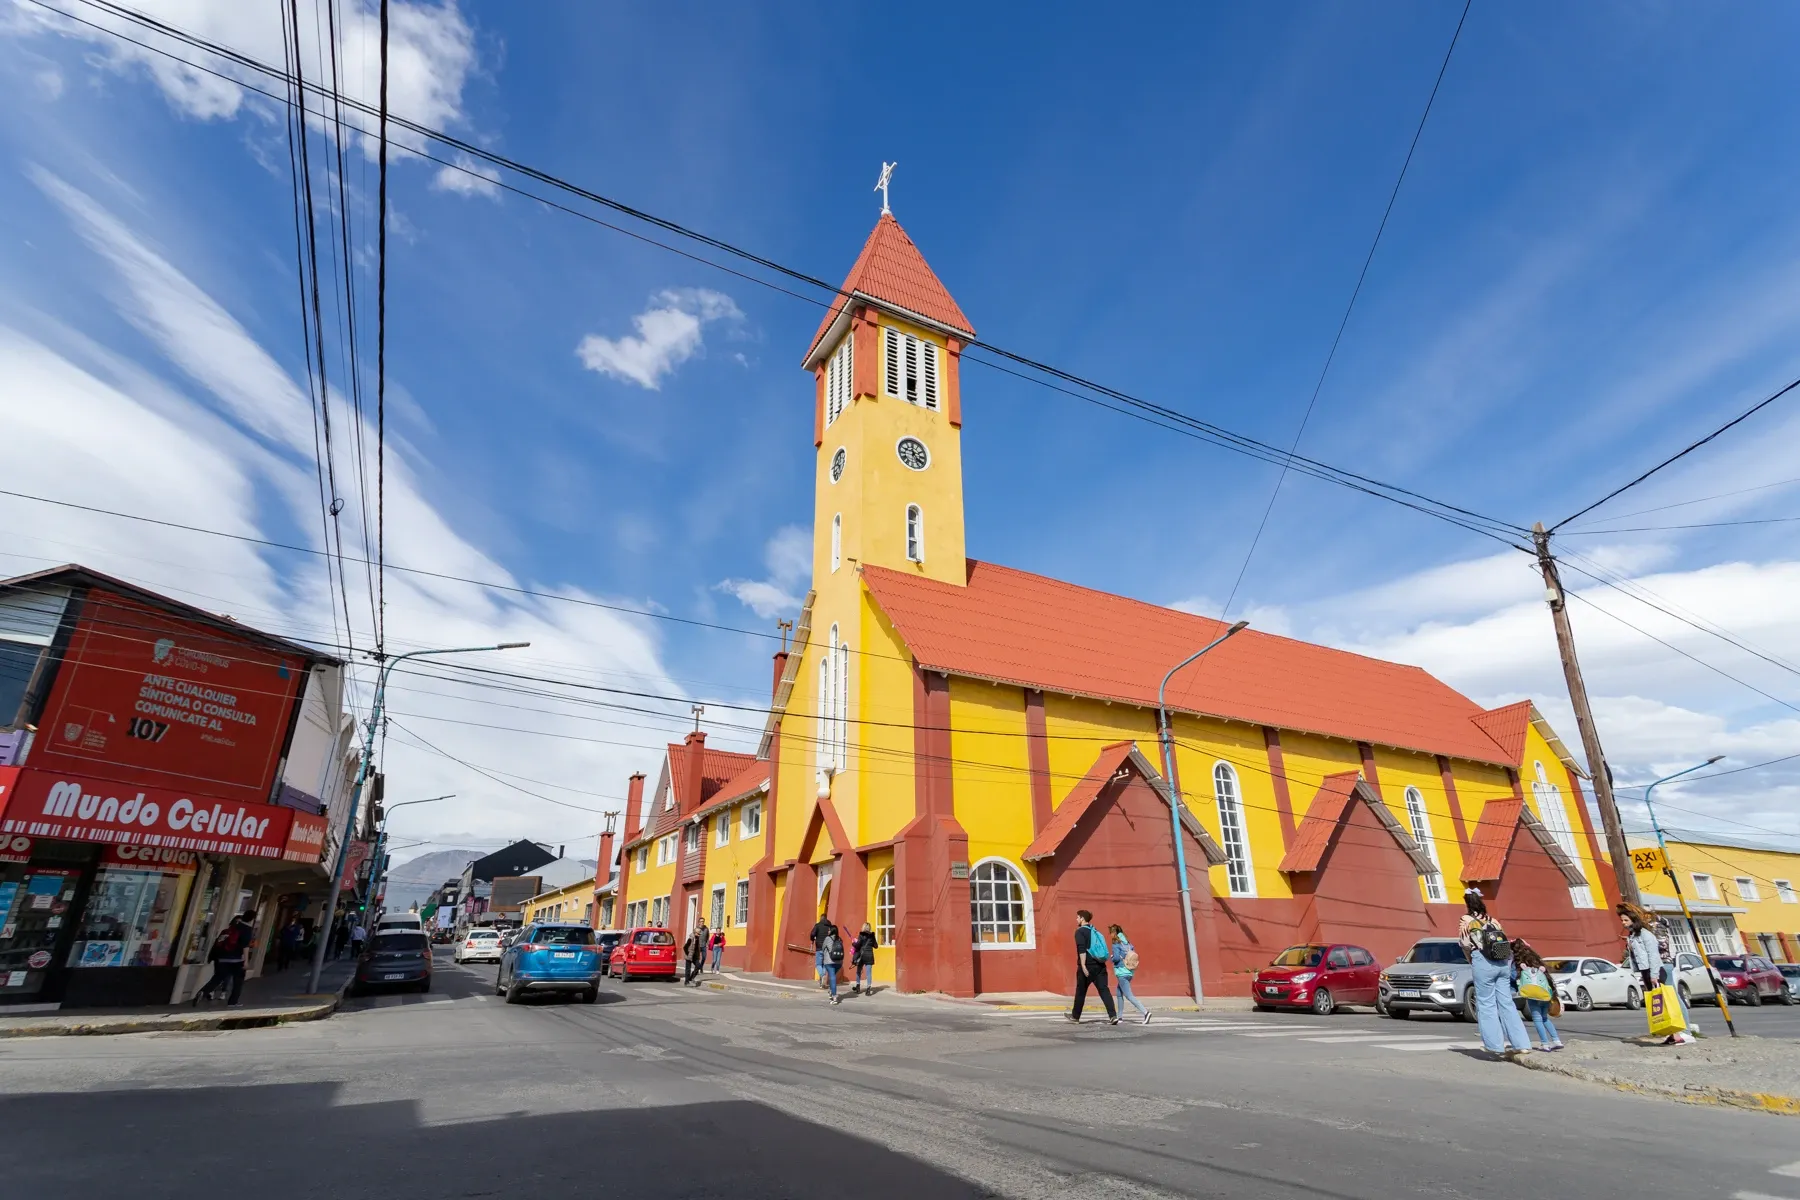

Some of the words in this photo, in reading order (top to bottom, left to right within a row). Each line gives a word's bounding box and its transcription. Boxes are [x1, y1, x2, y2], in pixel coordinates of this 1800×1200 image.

[143, 673, 175, 690] ANTE
[175, 681, 237, 706] CUALQUIER
[192, 700, 202, 711] O
[203, 703, 256, 725] CONSULTA
[208, 719, 222, 731] AL
[126, 716, 170, 743] 107
[42, 780, 160, 827] Mundo
[167, 798, 270, 840] Celular
[1634, 851, 1658, 863] AXI
[1636, 861, 1654, 871] 44
